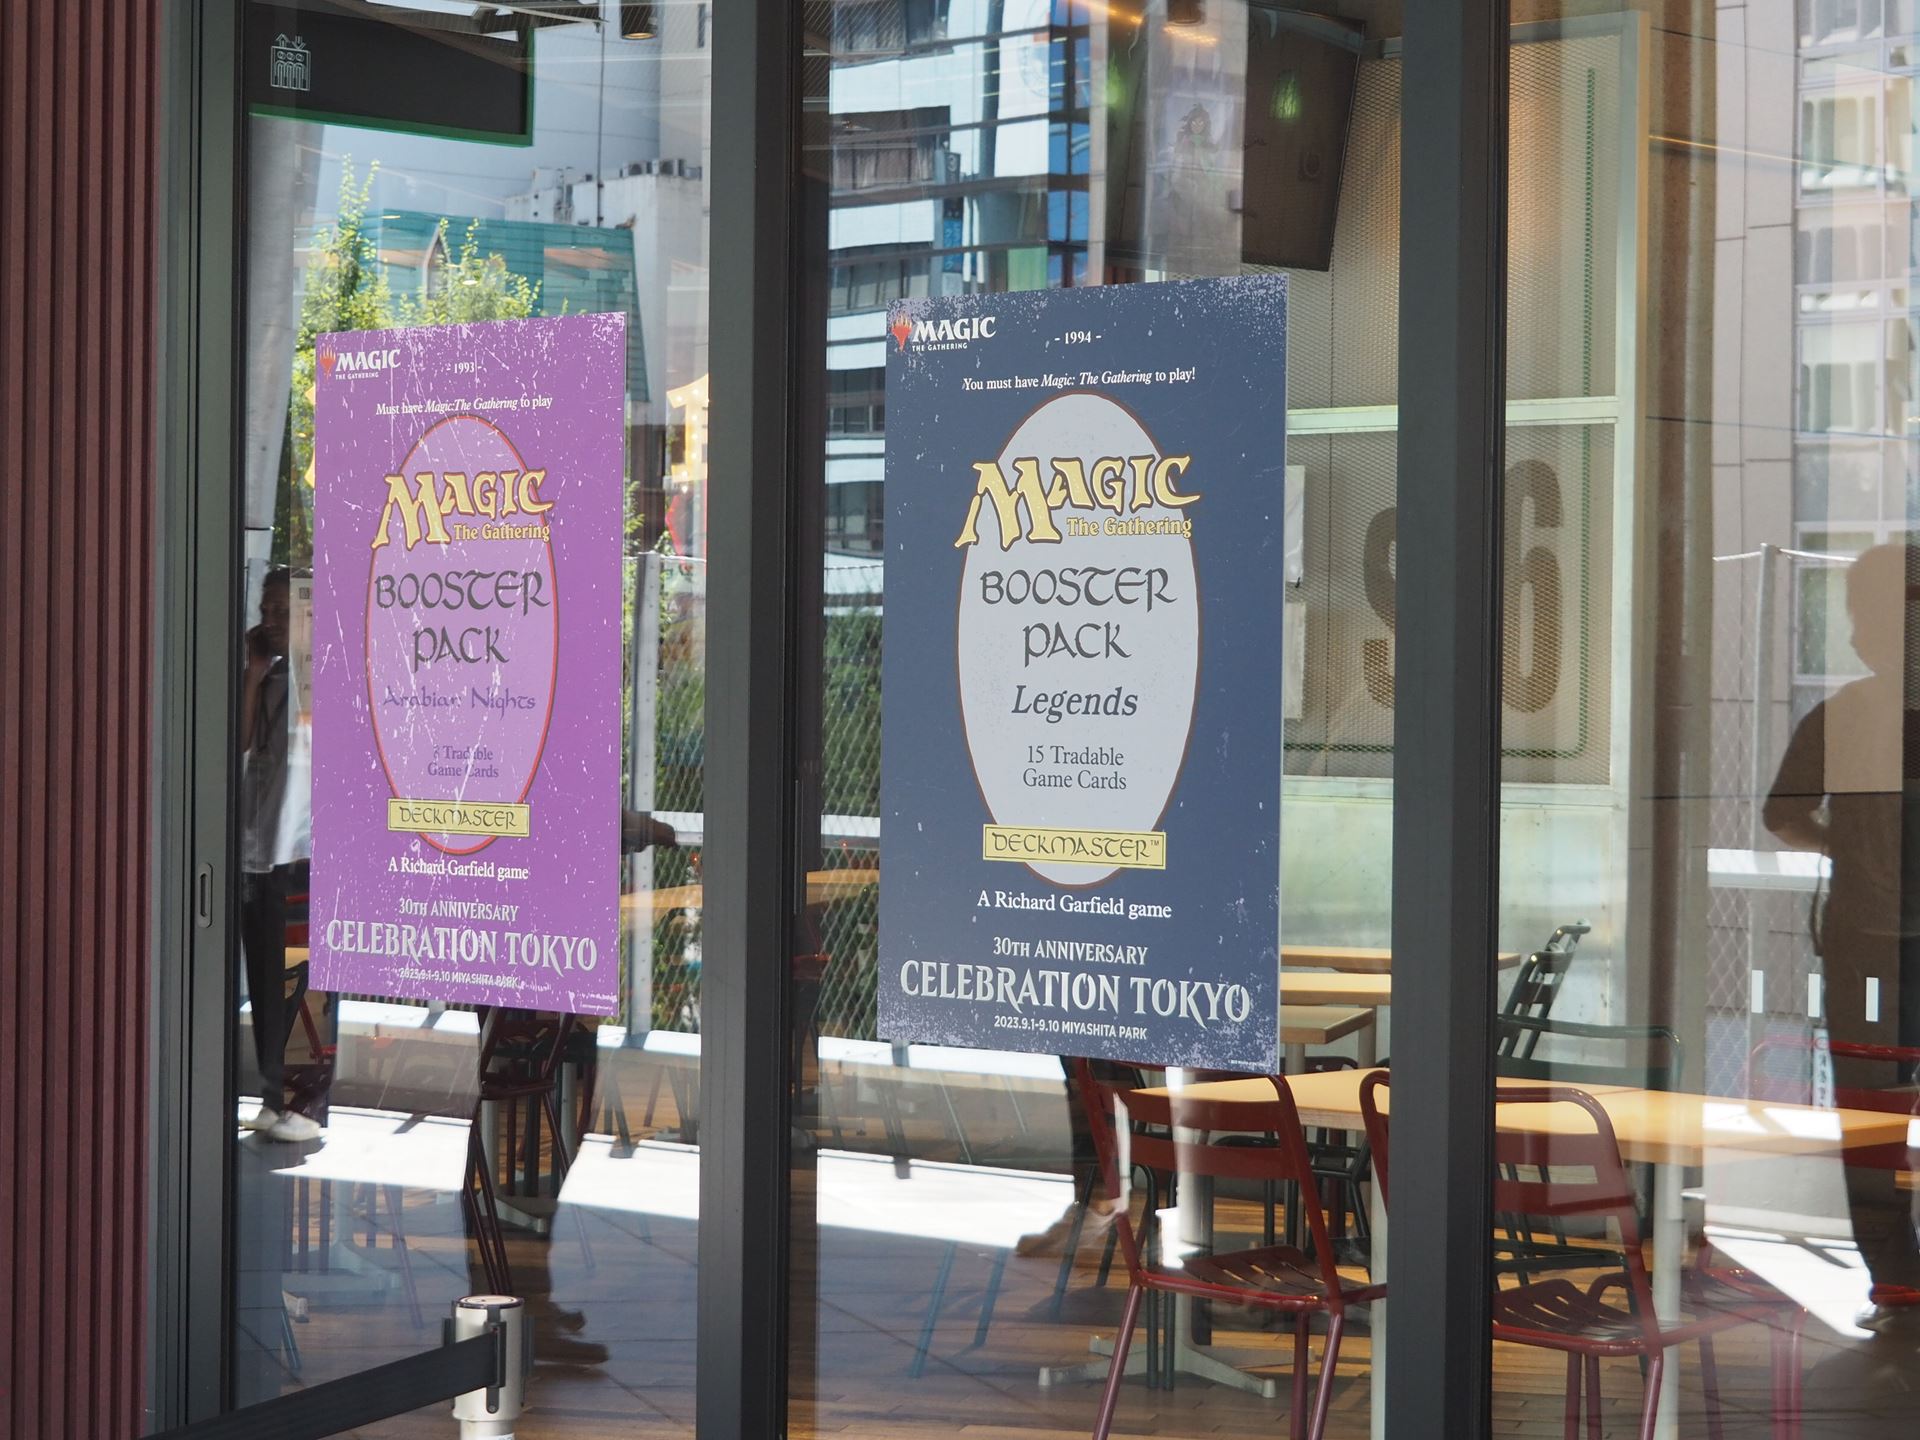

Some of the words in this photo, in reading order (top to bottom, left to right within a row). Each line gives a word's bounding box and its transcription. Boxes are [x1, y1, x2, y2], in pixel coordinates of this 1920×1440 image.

[912, 316, 997, 342] MAGIC
[1064, 331, 1092, 345] 1994
[912, 343, 925, 352] THE
[927, 342, 968, 351] GATHERING
[335, 349, 401, 372] MAGIC
[454, 362, 475, 374] 1993
[963, 378, 983, 391] You
[986, 377, 1012, 390] must
[1014, 375, 1039, 389] have
[1041, 373, 1075, 389] Magic:
[1079, 372, 1099, 385] The
[1101, 370, 1152, 386] Gathering
[1155, 371, 1166, 382] to
[1169, 367, 1196, 384] play!
[376, 403, 400, 415] Must
[402, 402, 424, 414] have
[473, 397, 517, 411] Gathering
[520, 397, 531, 408] to
[532, 395, 553, 410] play
[371, 469, 554, 551] MAGIC
[953, 454, 1202, 551] MAGIC
[454, 524, 478, 540] The
[481, 522, 550, 542] Gathering
[1066, 517, 1099, 537] The
[1103, 515, 1193, 540] Gathering
[374, 570, 551, 616] BOOSTER
[980, 566, 1178, 613] BOOSTER
[413, 626, 510, 673] PACK
[1022, 621, 1132, 667] PACK
[471, 687, 536, 719] Nights
[1011, 685, 1138, 724] Legends
[1027, 745, 1044, 764] 15
[1050, 745, 1124, 766] Tradable
[428, 762, 462, 776] Game
[465, 763, 499, 778] Cards
[1023, 768, 1073, 789] Game
[1077, 770, 1127, 790] Cards
[400, 806, 518, 830] DECKMASTER
[388, 857, 399, 872] A
[401, 858, 446, 875] Richard
[448, 860, 494, 878] Garfield
[498, 865, 529, 881] game
[399, 898, 428, 917] 30TH
[431, 900, 519, 922] ANNIVERSARY
[976, 890, 990, 907] A
[994, 890, 1056, 912] Richard
[1060, 894, 1124, 915] Garfield
[1128, 902, 1172, 920] game
[326, 919, 496, 967] CELEBRATION
[504, 932, 598, 978] TOKYO
[993, 936, 1030, 957] 30TH
[1034, 940, 1149, 966] ANNIVERSARY
[452, 971, 494, 985] MIYASHITA
[899, 959, 1120, 1014] CELEBRATION
[1129, 977, 1251, 1030] TOKYO
[994, 1015, 1060, 1032] 2023.9.1-9.10
[1062, 1021, 1117, 1037] MIYASHITA
[1119, 1026, 1147, 1040] PARK
